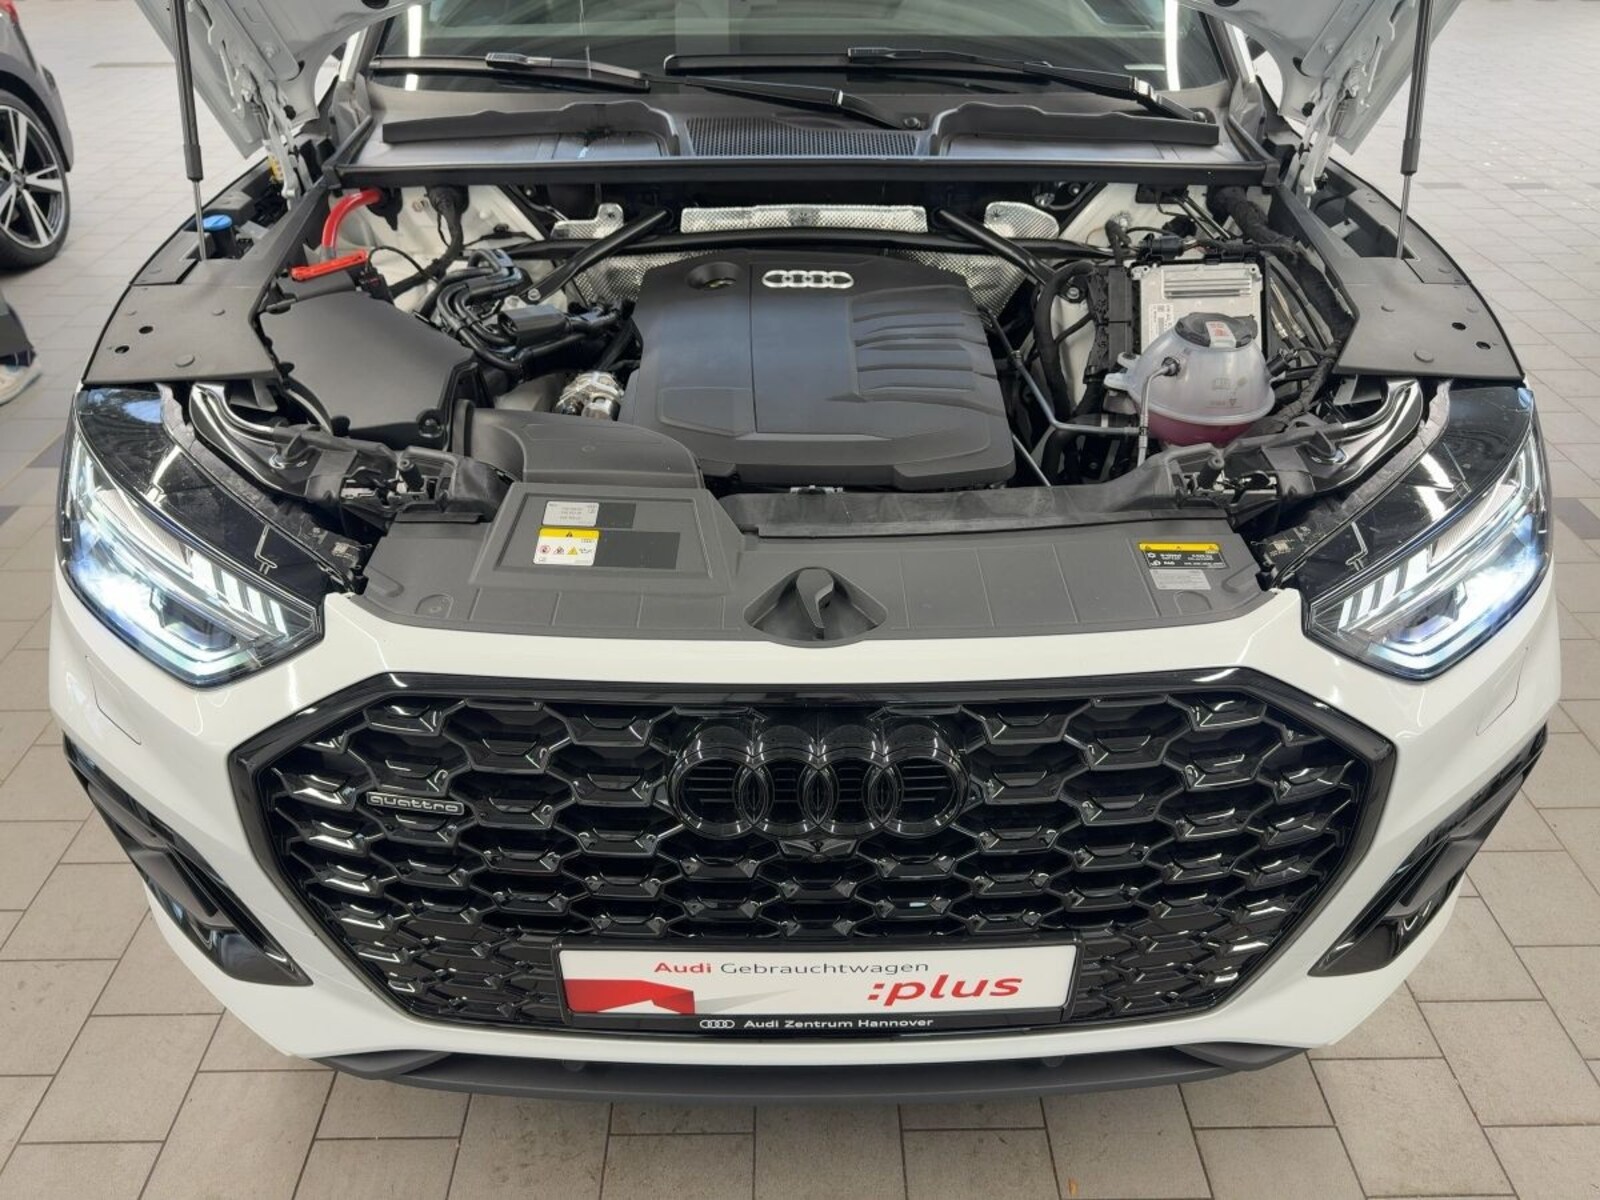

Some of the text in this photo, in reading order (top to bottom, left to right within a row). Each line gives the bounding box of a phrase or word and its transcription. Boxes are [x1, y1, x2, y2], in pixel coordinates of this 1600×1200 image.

[369, 794, 459, 812] quattro
[653, 960, 930, 976] Audi Gebrauchtwagen
[743, 1017, 934, 1029] Audi Zentrum Hannover
